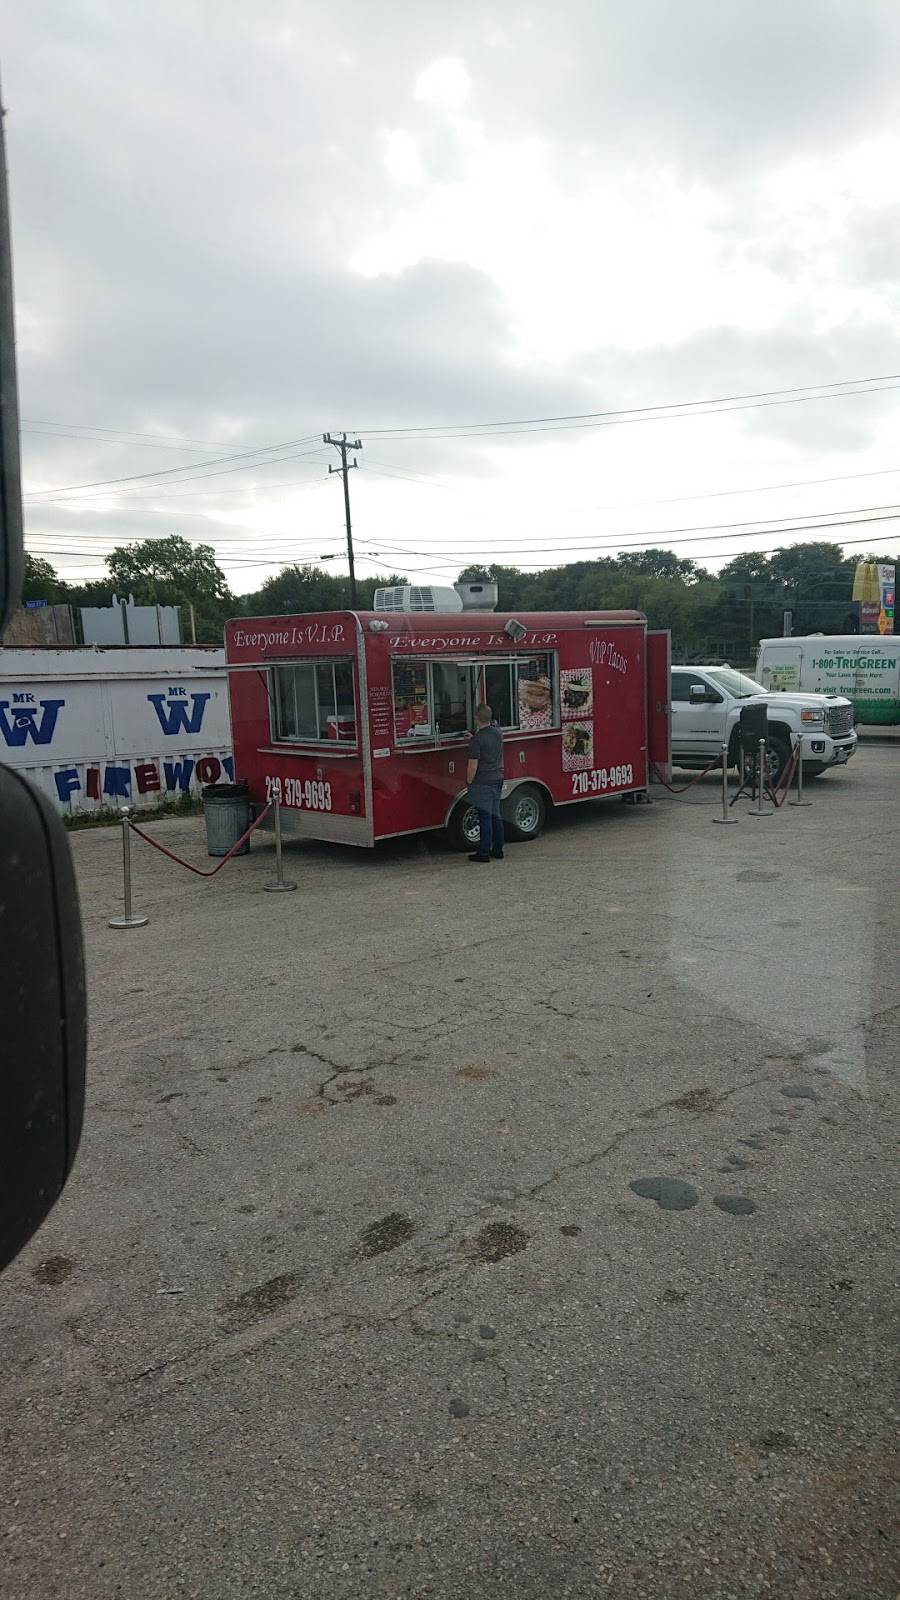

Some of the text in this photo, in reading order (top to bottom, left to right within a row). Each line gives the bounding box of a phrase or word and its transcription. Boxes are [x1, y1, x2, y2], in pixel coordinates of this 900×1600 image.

[233, 623, 345, 651] Everyone Is V.I.P.
[389, 635, 481, 650] Everyone
[487, 634, 504, 645] Is
[12, 693, 36, 703] MR
[168, 687, 187, 696] MR
[840, 686, 892, 695] trugreen.com
[0, 700, 65, 747] W
[147, 693, 211, 736] W
[572, 764, 633, 795] 210-379-9693
